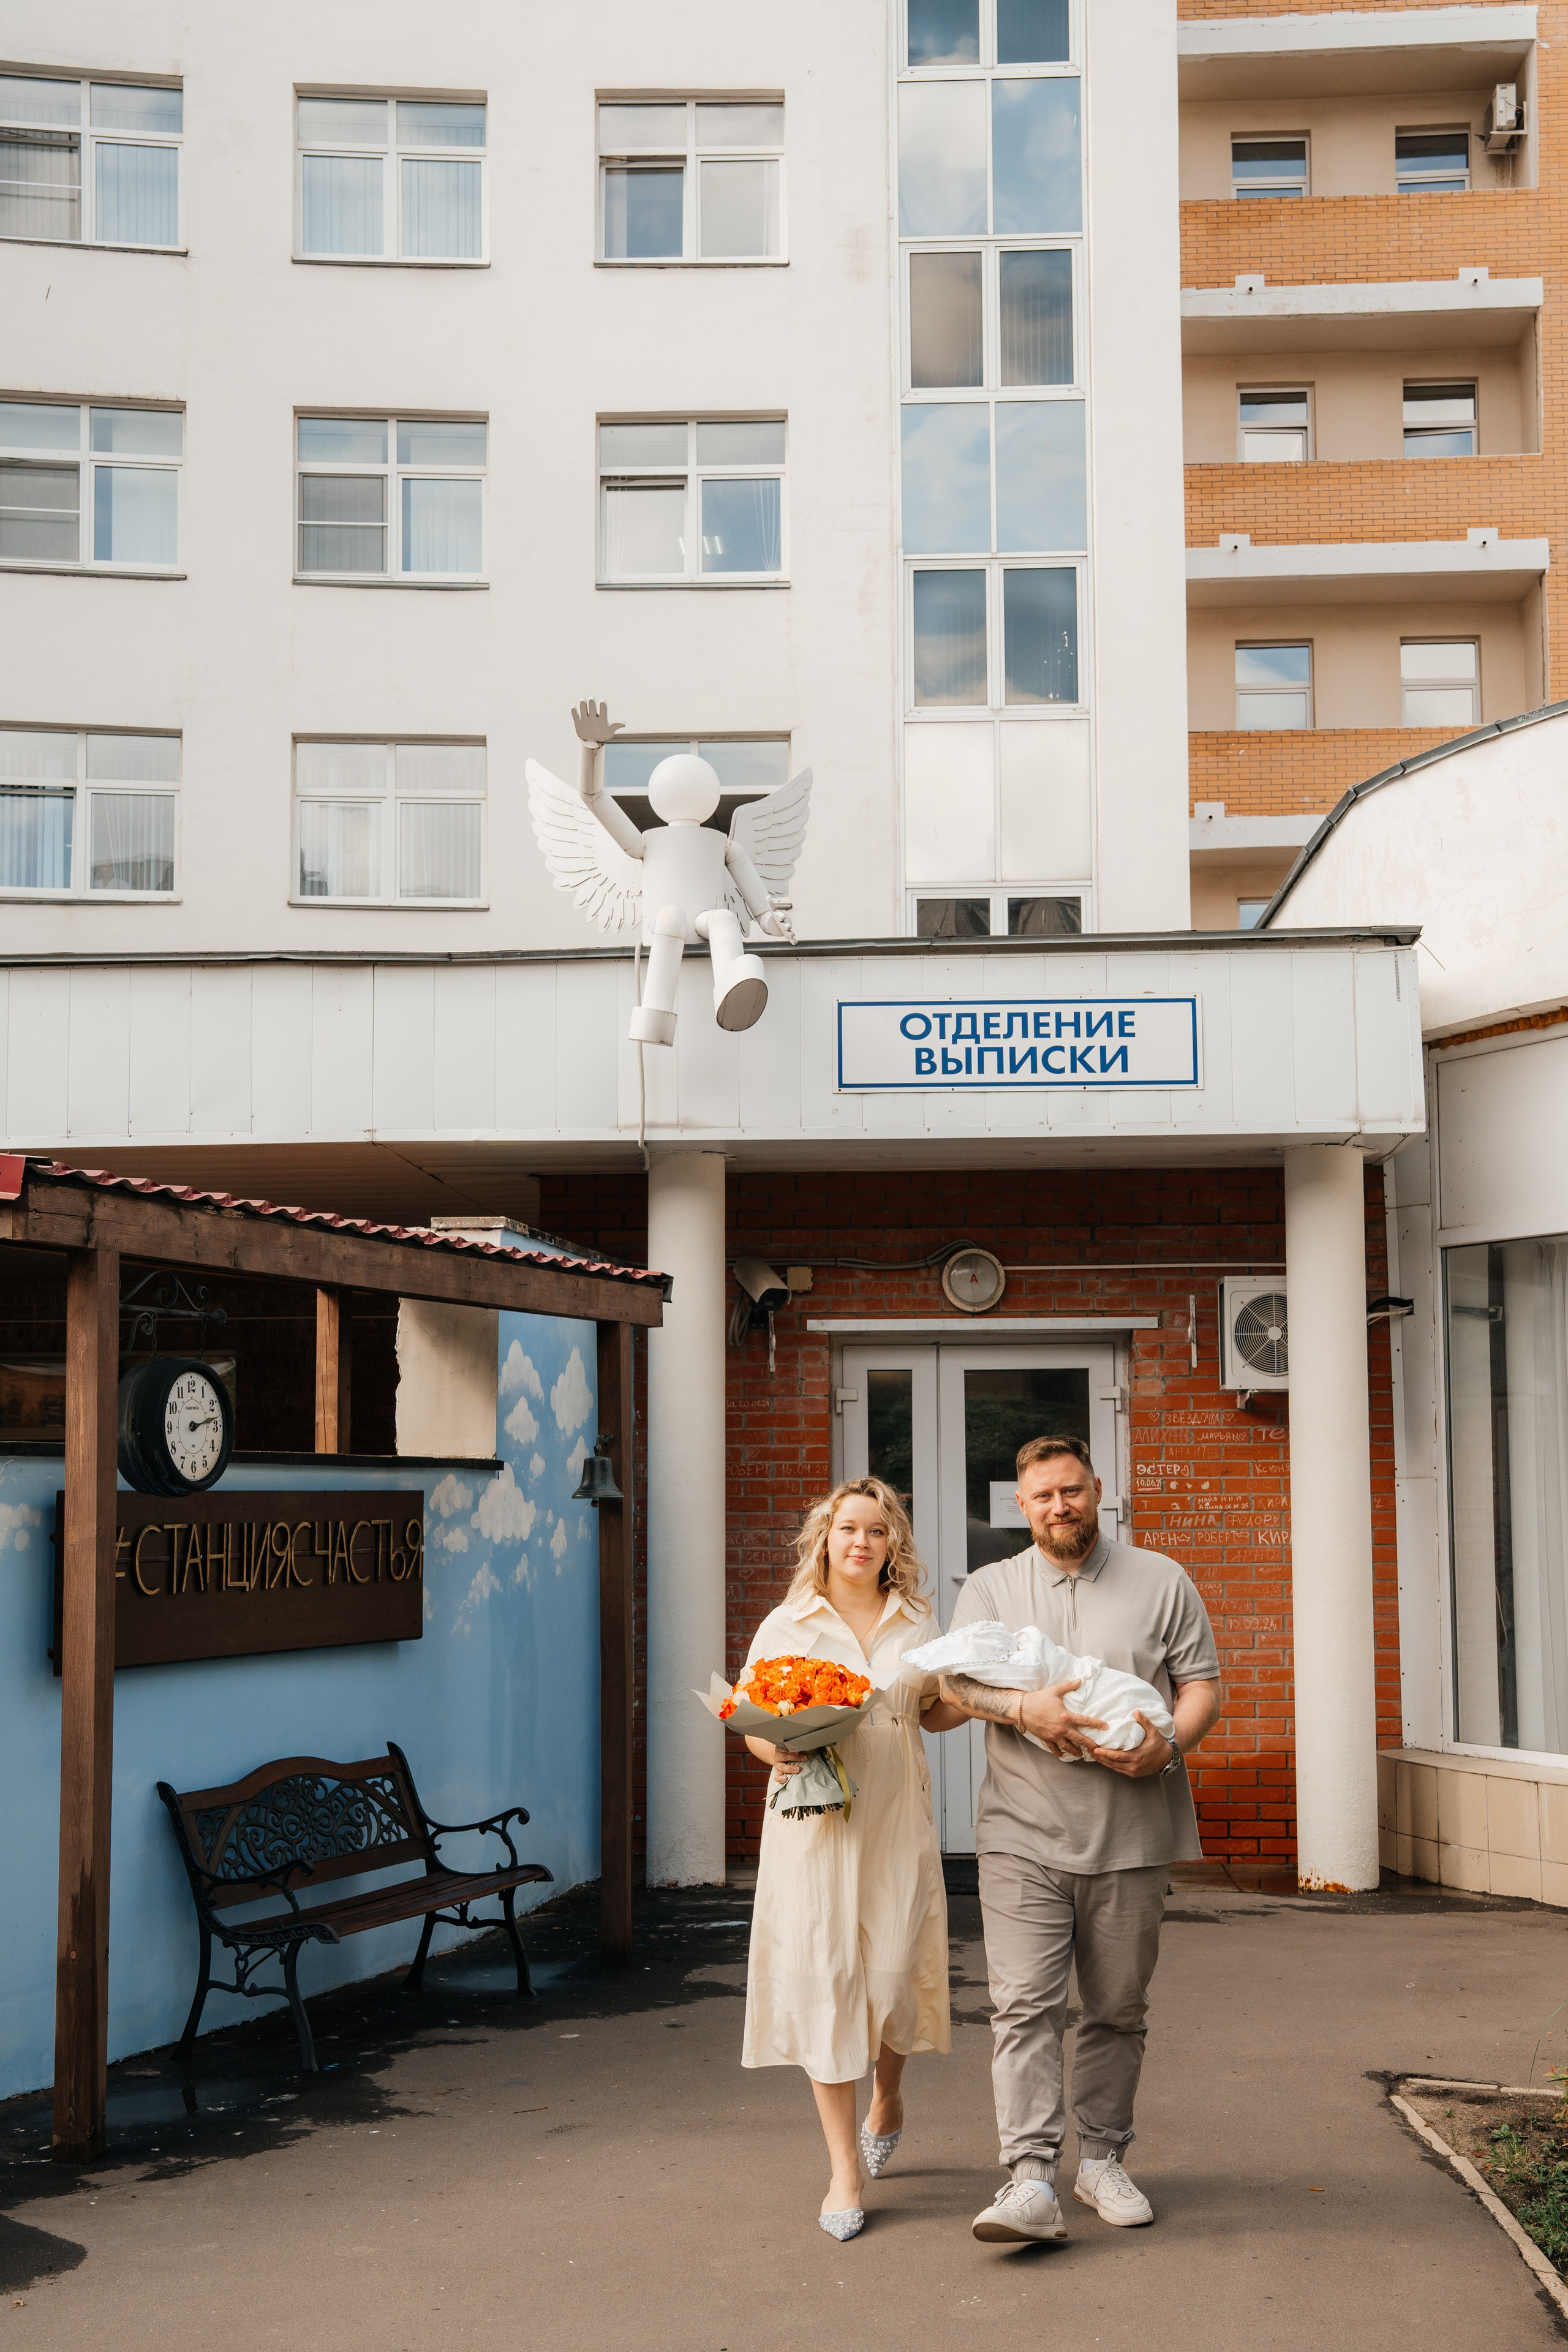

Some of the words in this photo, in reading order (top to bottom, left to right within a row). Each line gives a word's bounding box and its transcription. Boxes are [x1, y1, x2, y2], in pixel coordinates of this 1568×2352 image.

[900, 1011, 1136, 1045] ОТДЕЛЕНИЕ
[914, 1046, 1129, 1075] ВЫПИСКИ
[177, 1386, 184, 1399] 11
[187, 1380, 195, 1393] 12
[201, 1385, 205, 1398] 1
[168, 1401, 178, 1414] 10
[209, 1400, 214, 1412] 2
[1165, 1411, 1219, 1425] ЗВЁЗДОЧКА
[167, 1421, 172, 1434] 9
[213, 1420, 218, 1433] 3
[170, 1441, 176, 1455] 8
[209, 1439, 215, 1452] 4
[180, 1456, 186, 1469] 7
[190, 1460, 196, 1474] 6
[202, 1455, 207, 1468] 5
[1136, 1463, 1181, 1476] ЭСТЕР
[1170, 1515, 1216, 1528] НИНА
[1144, 1532, 1177, 1547] АРЕН
[1197, 1531, 1236, 1543] РОБЕРТ
